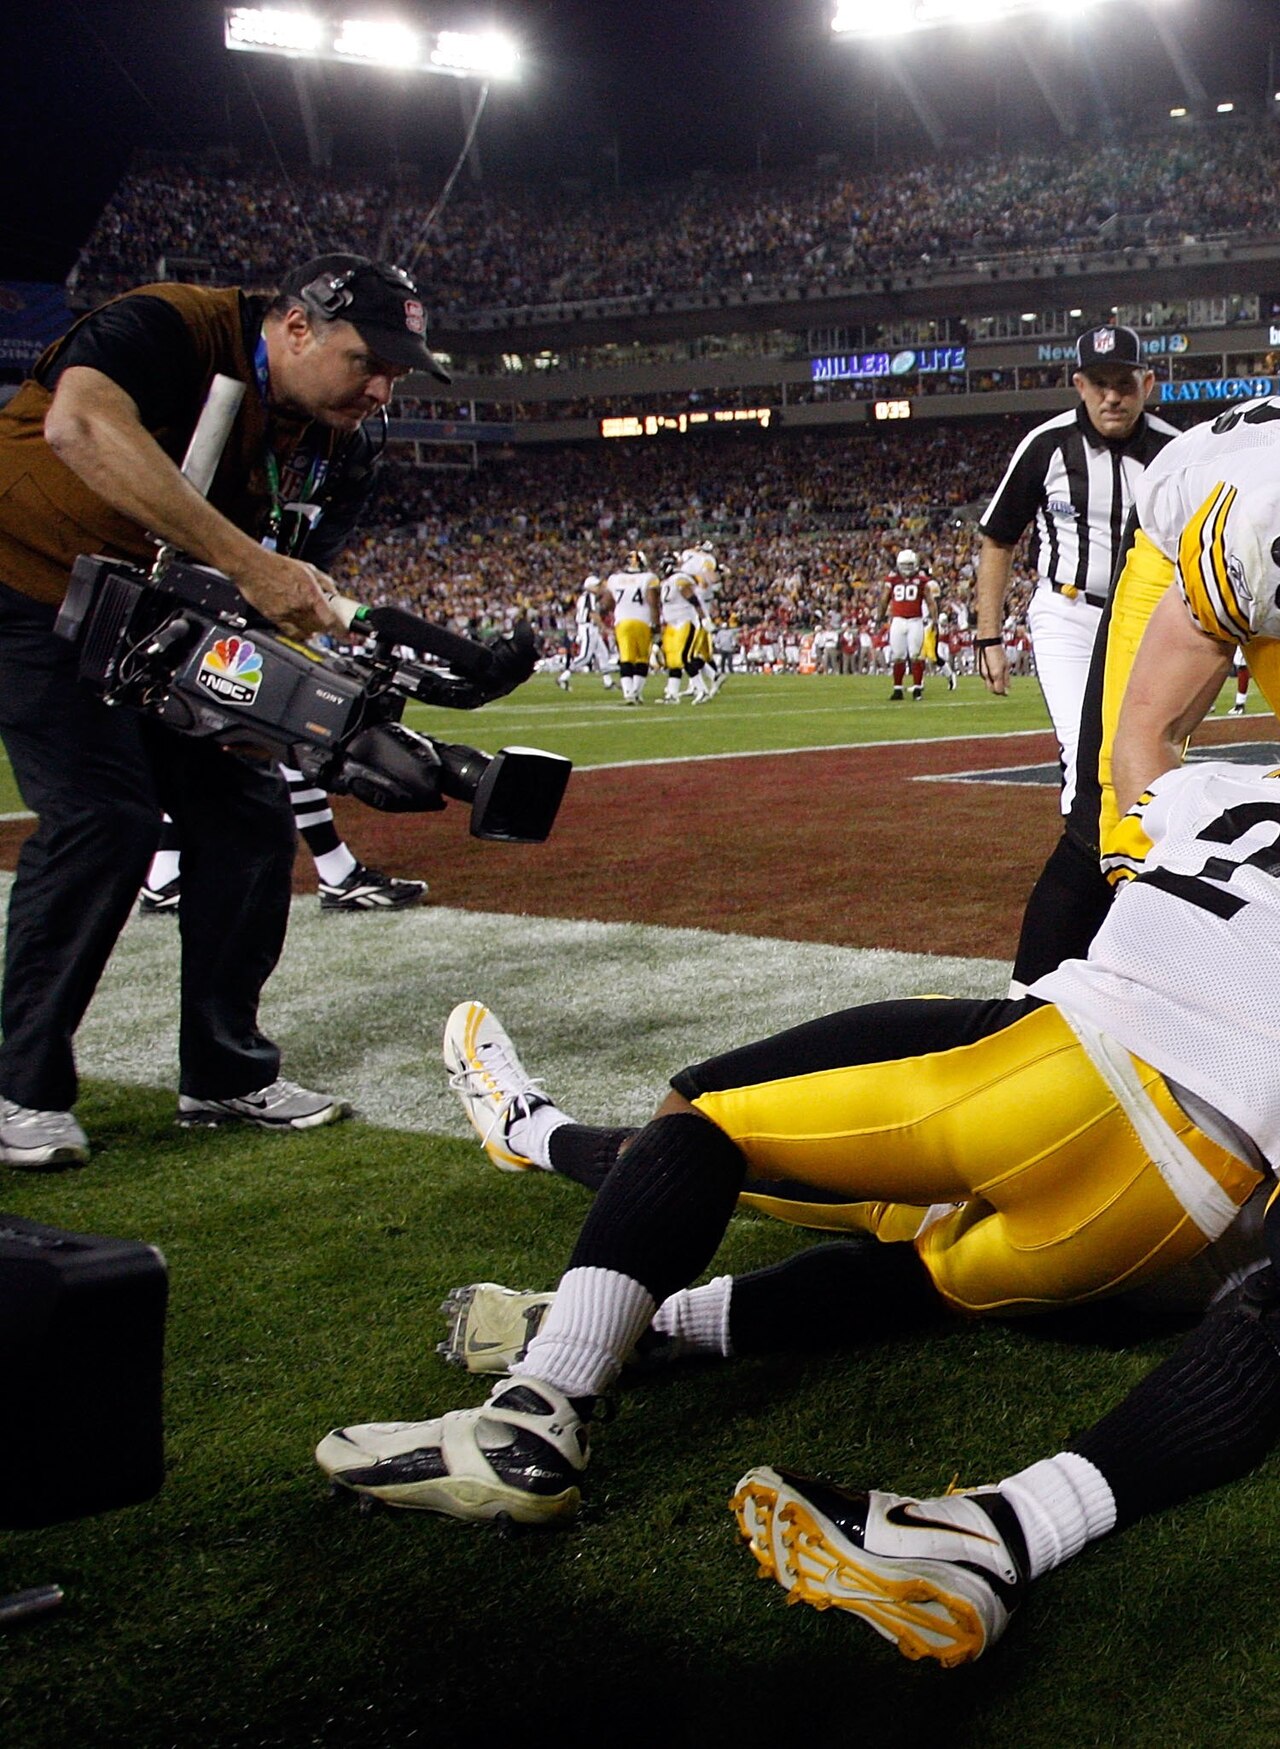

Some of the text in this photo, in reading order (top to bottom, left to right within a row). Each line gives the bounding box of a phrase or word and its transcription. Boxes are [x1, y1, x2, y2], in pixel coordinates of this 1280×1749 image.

[1038, 344, 1077, 360] New
[812, 347, 965, 382] MILLER LITE
[1160, 377, 1272, 401] RAYMOND
[615, 587, 644, 606] 74
[893, 584, 919, 602] 90
[206, 674, 246, 700] NBC
[316, 688, 345, 705] SONY
